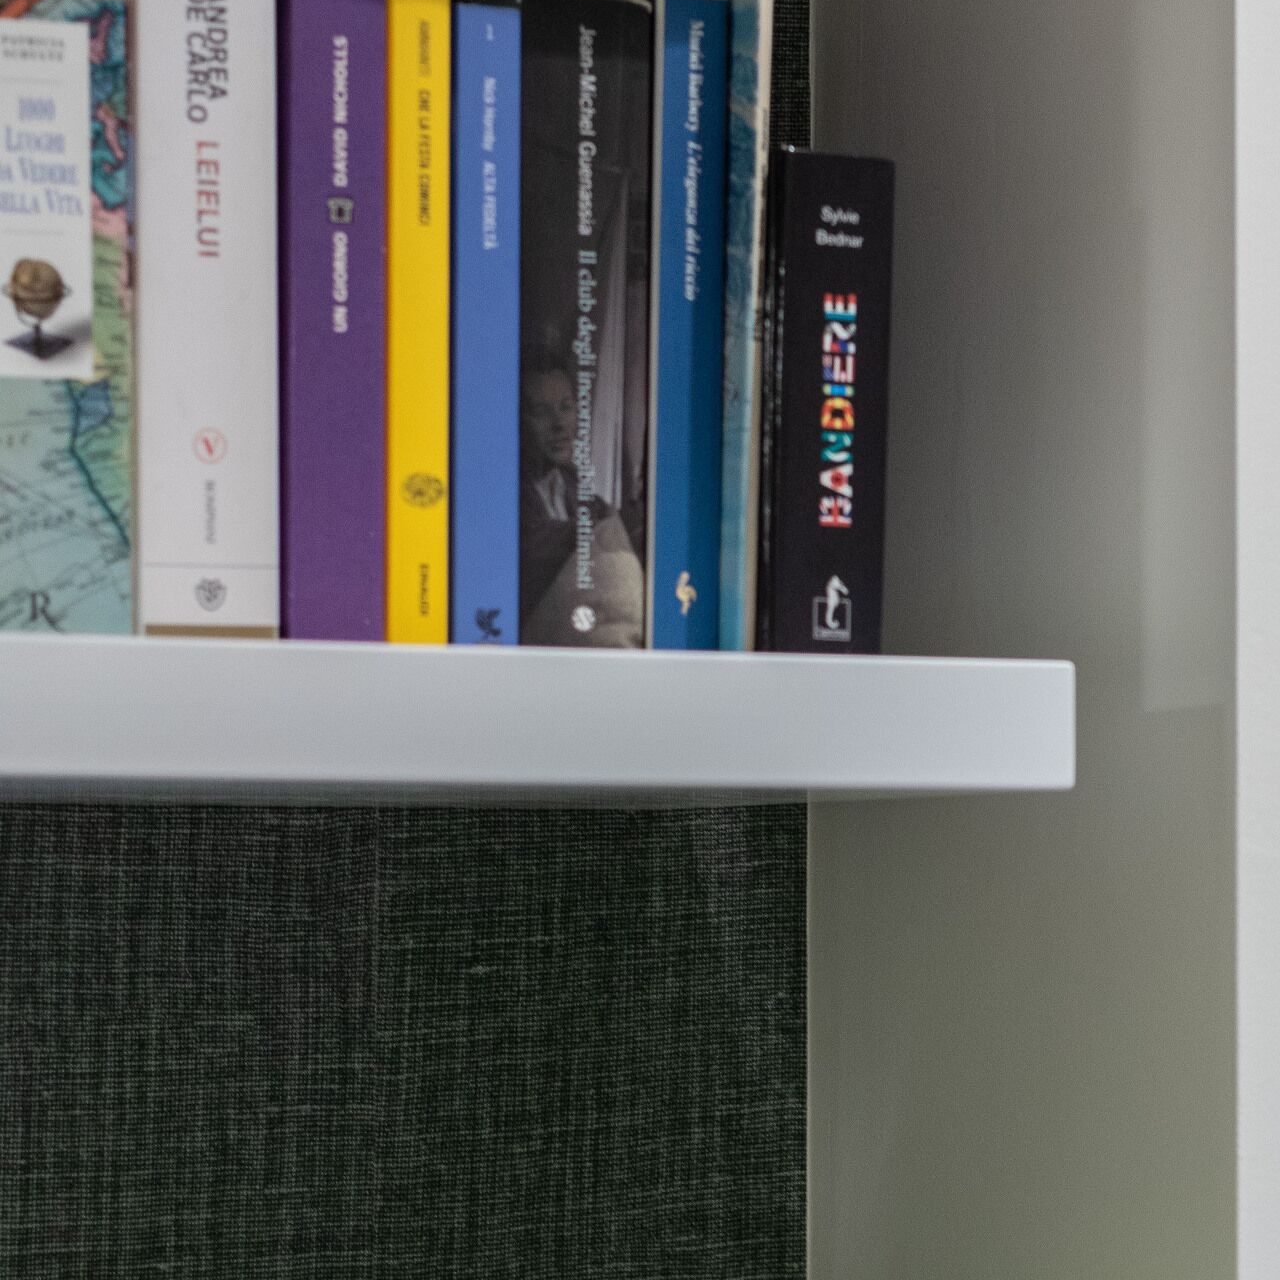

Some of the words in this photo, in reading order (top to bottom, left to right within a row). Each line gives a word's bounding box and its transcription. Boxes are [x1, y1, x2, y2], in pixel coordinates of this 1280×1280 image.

[186, 32, 208, 124] CARLO
[332, 34, 348, 124] NICHOLLS
[579, 24, 598, 136] Jean-Michel
[332, 127, 348, 188] DAVID
[578, 140, 597, 236] Guenassia
[815, 228, 864, 249] Bednar
[820, 204, 861, 226] Sylvie
[332, 231, 348, 303] GIORNO
[578, 268, 598, 312] club
[332, 305, 348, 334] UN
[572, 315, 598, 366] degli
[819, 292, 857, 528] BANDIERE
[576, 505, 595, 589] ottimisti
